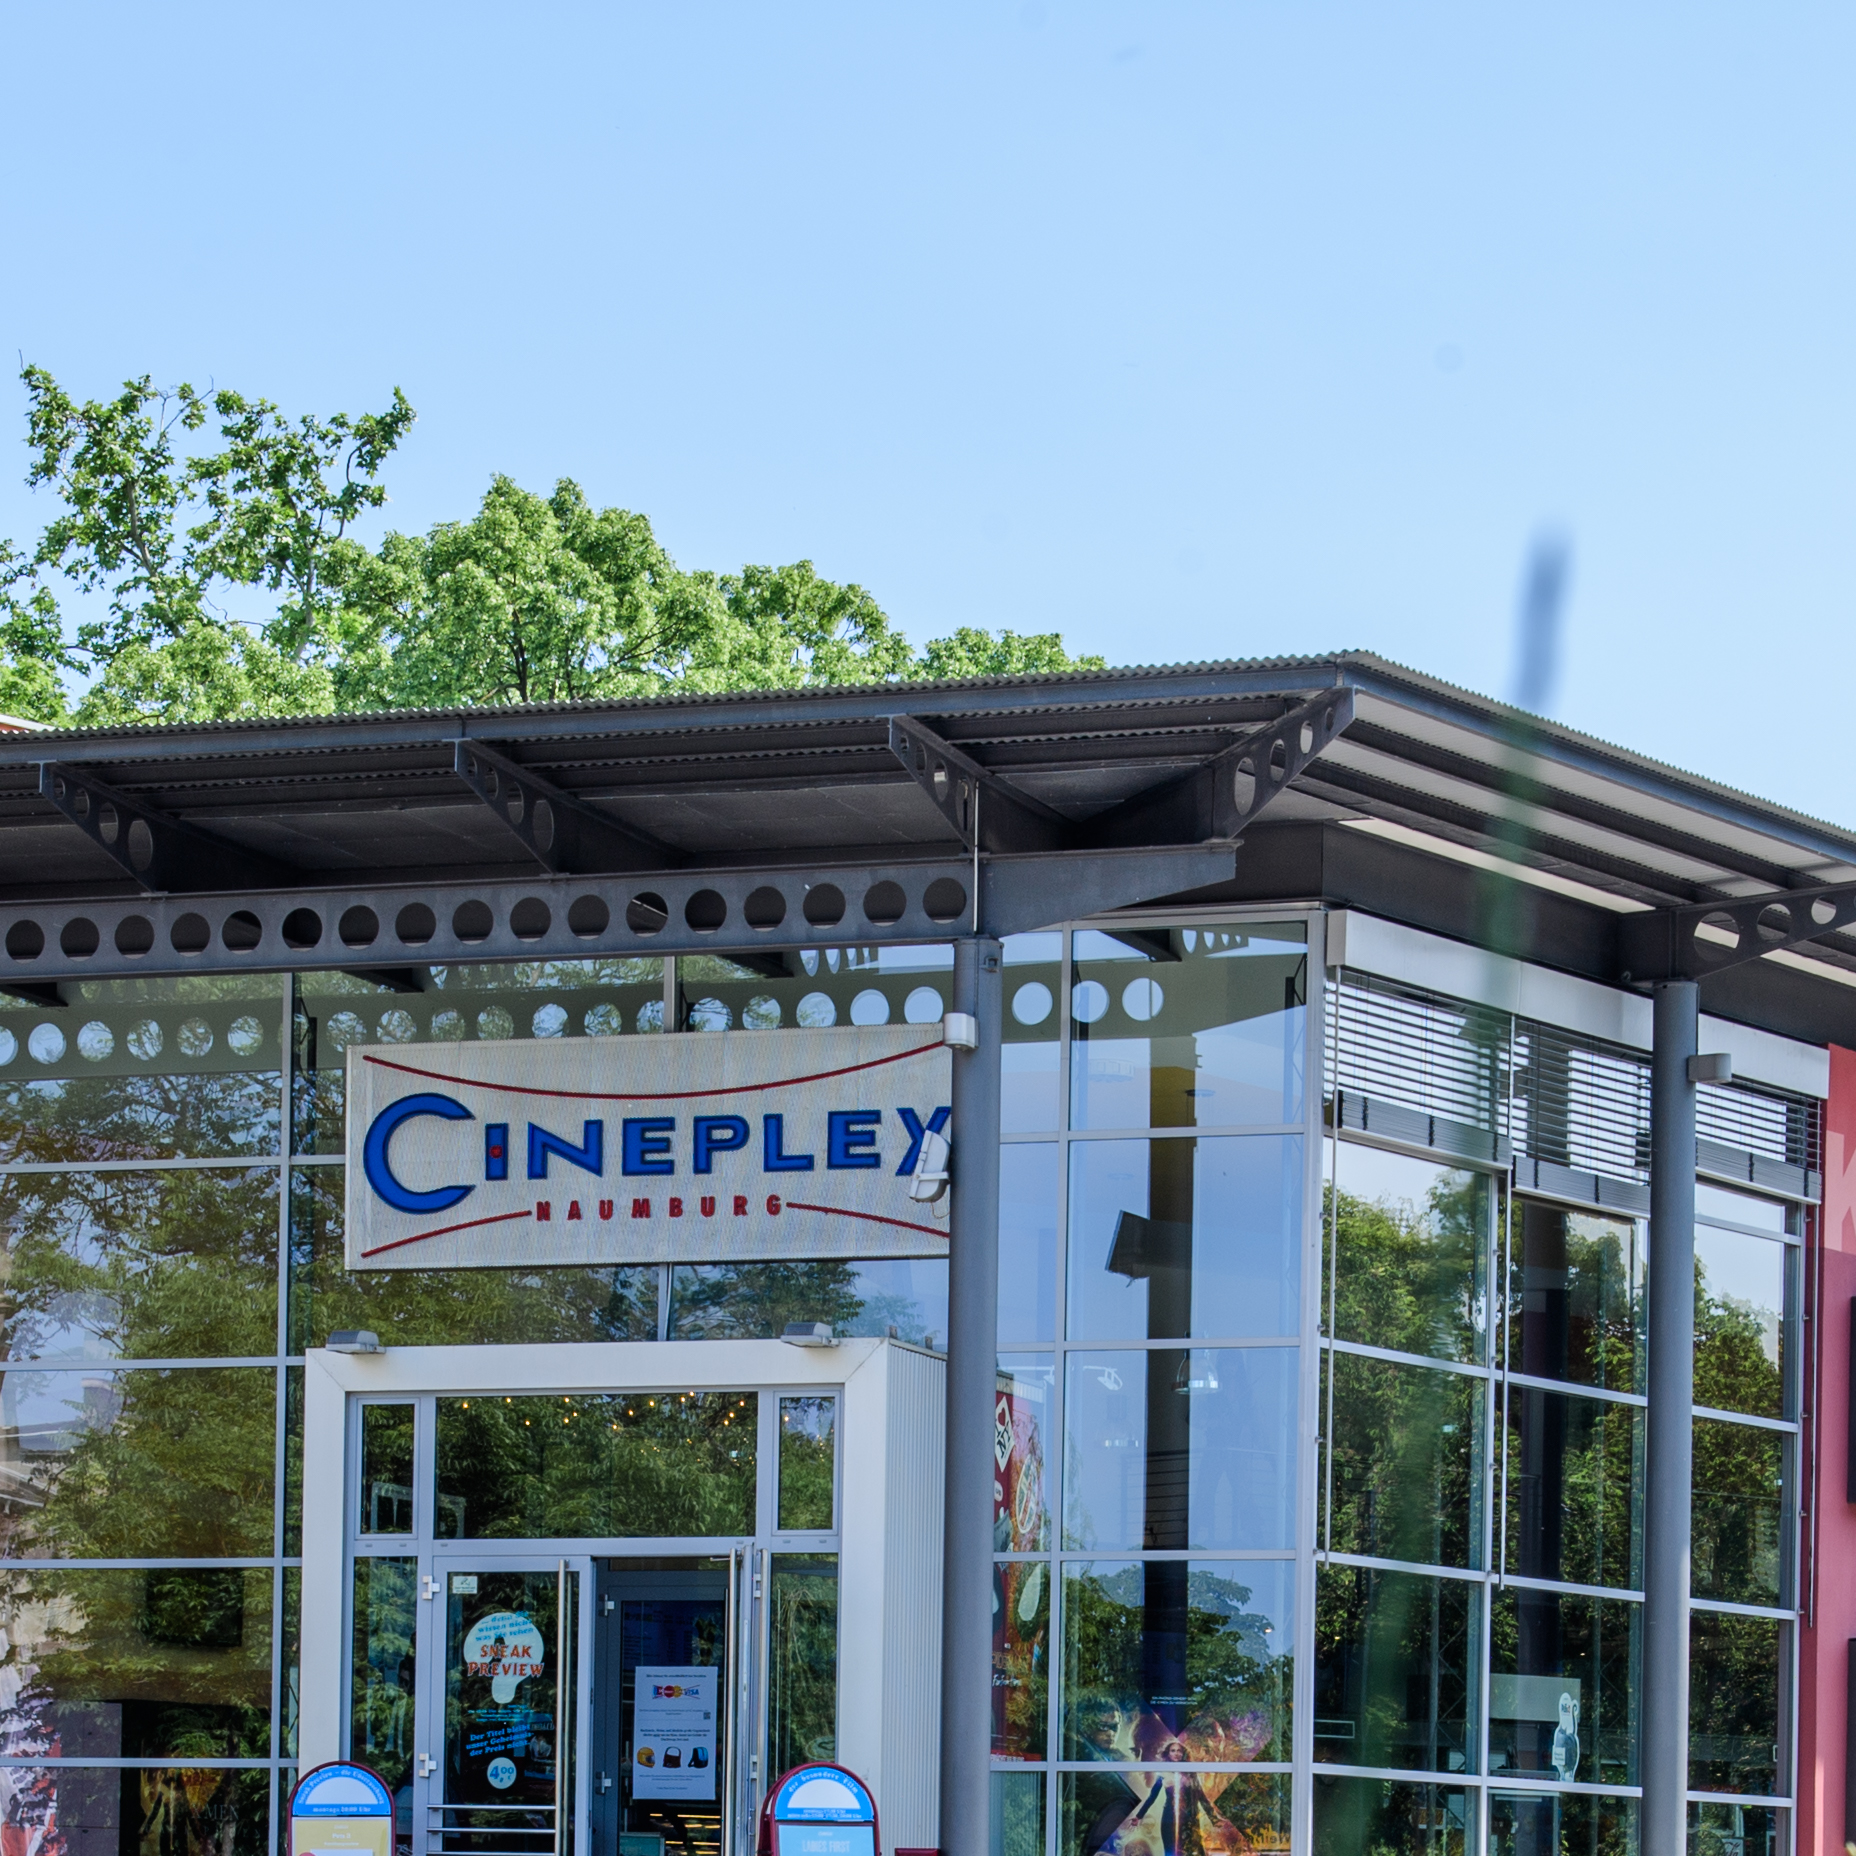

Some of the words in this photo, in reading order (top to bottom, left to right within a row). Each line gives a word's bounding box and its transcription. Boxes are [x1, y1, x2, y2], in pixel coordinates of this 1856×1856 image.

[363, 1092, 951, 1215] CINEPLEX
[537, 1194, 782, 1222] NAUMBURG
[480, 1644, 532, 1658] SNEAK
[467, 1661, 545, 1678] PREVIEW
[469, 1733, 485, 1742] Der
